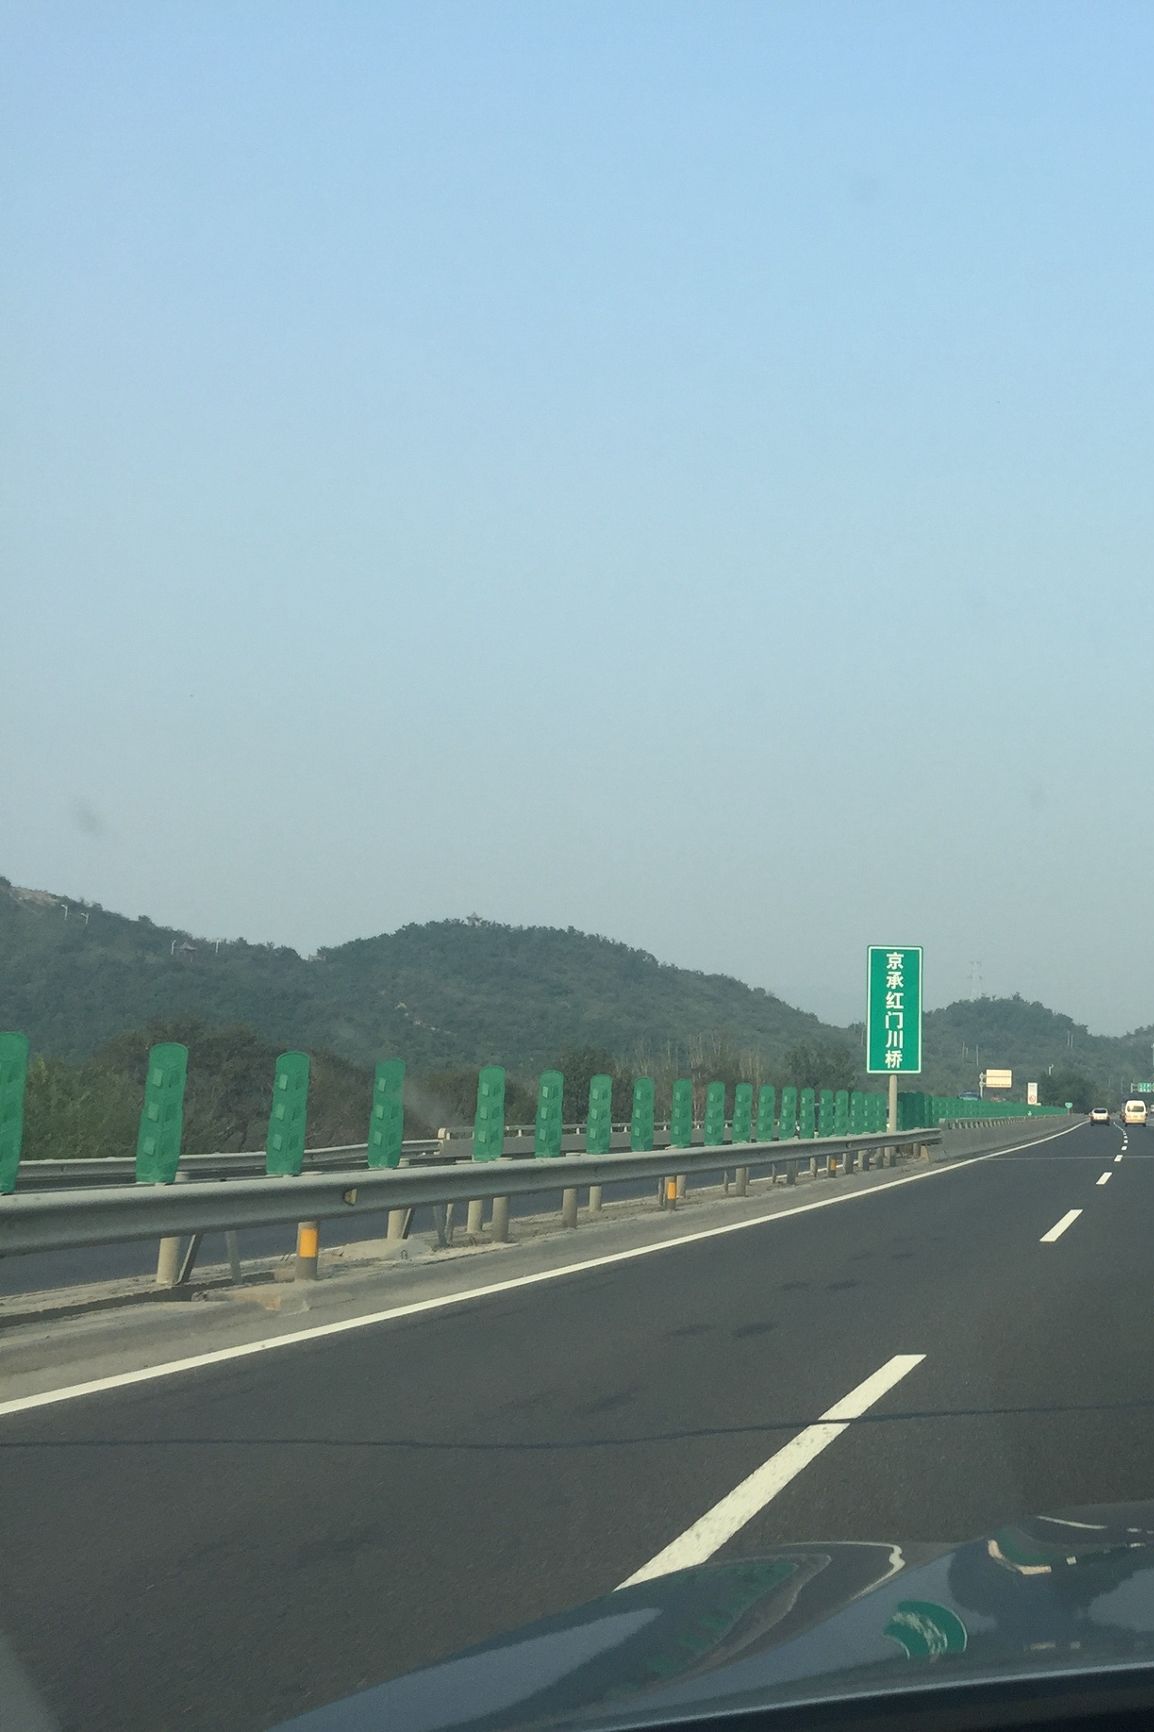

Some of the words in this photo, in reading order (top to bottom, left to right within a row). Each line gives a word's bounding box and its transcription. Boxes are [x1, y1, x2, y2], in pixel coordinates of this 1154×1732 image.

[885, 952, 904, 1069] 京承红门川桥
